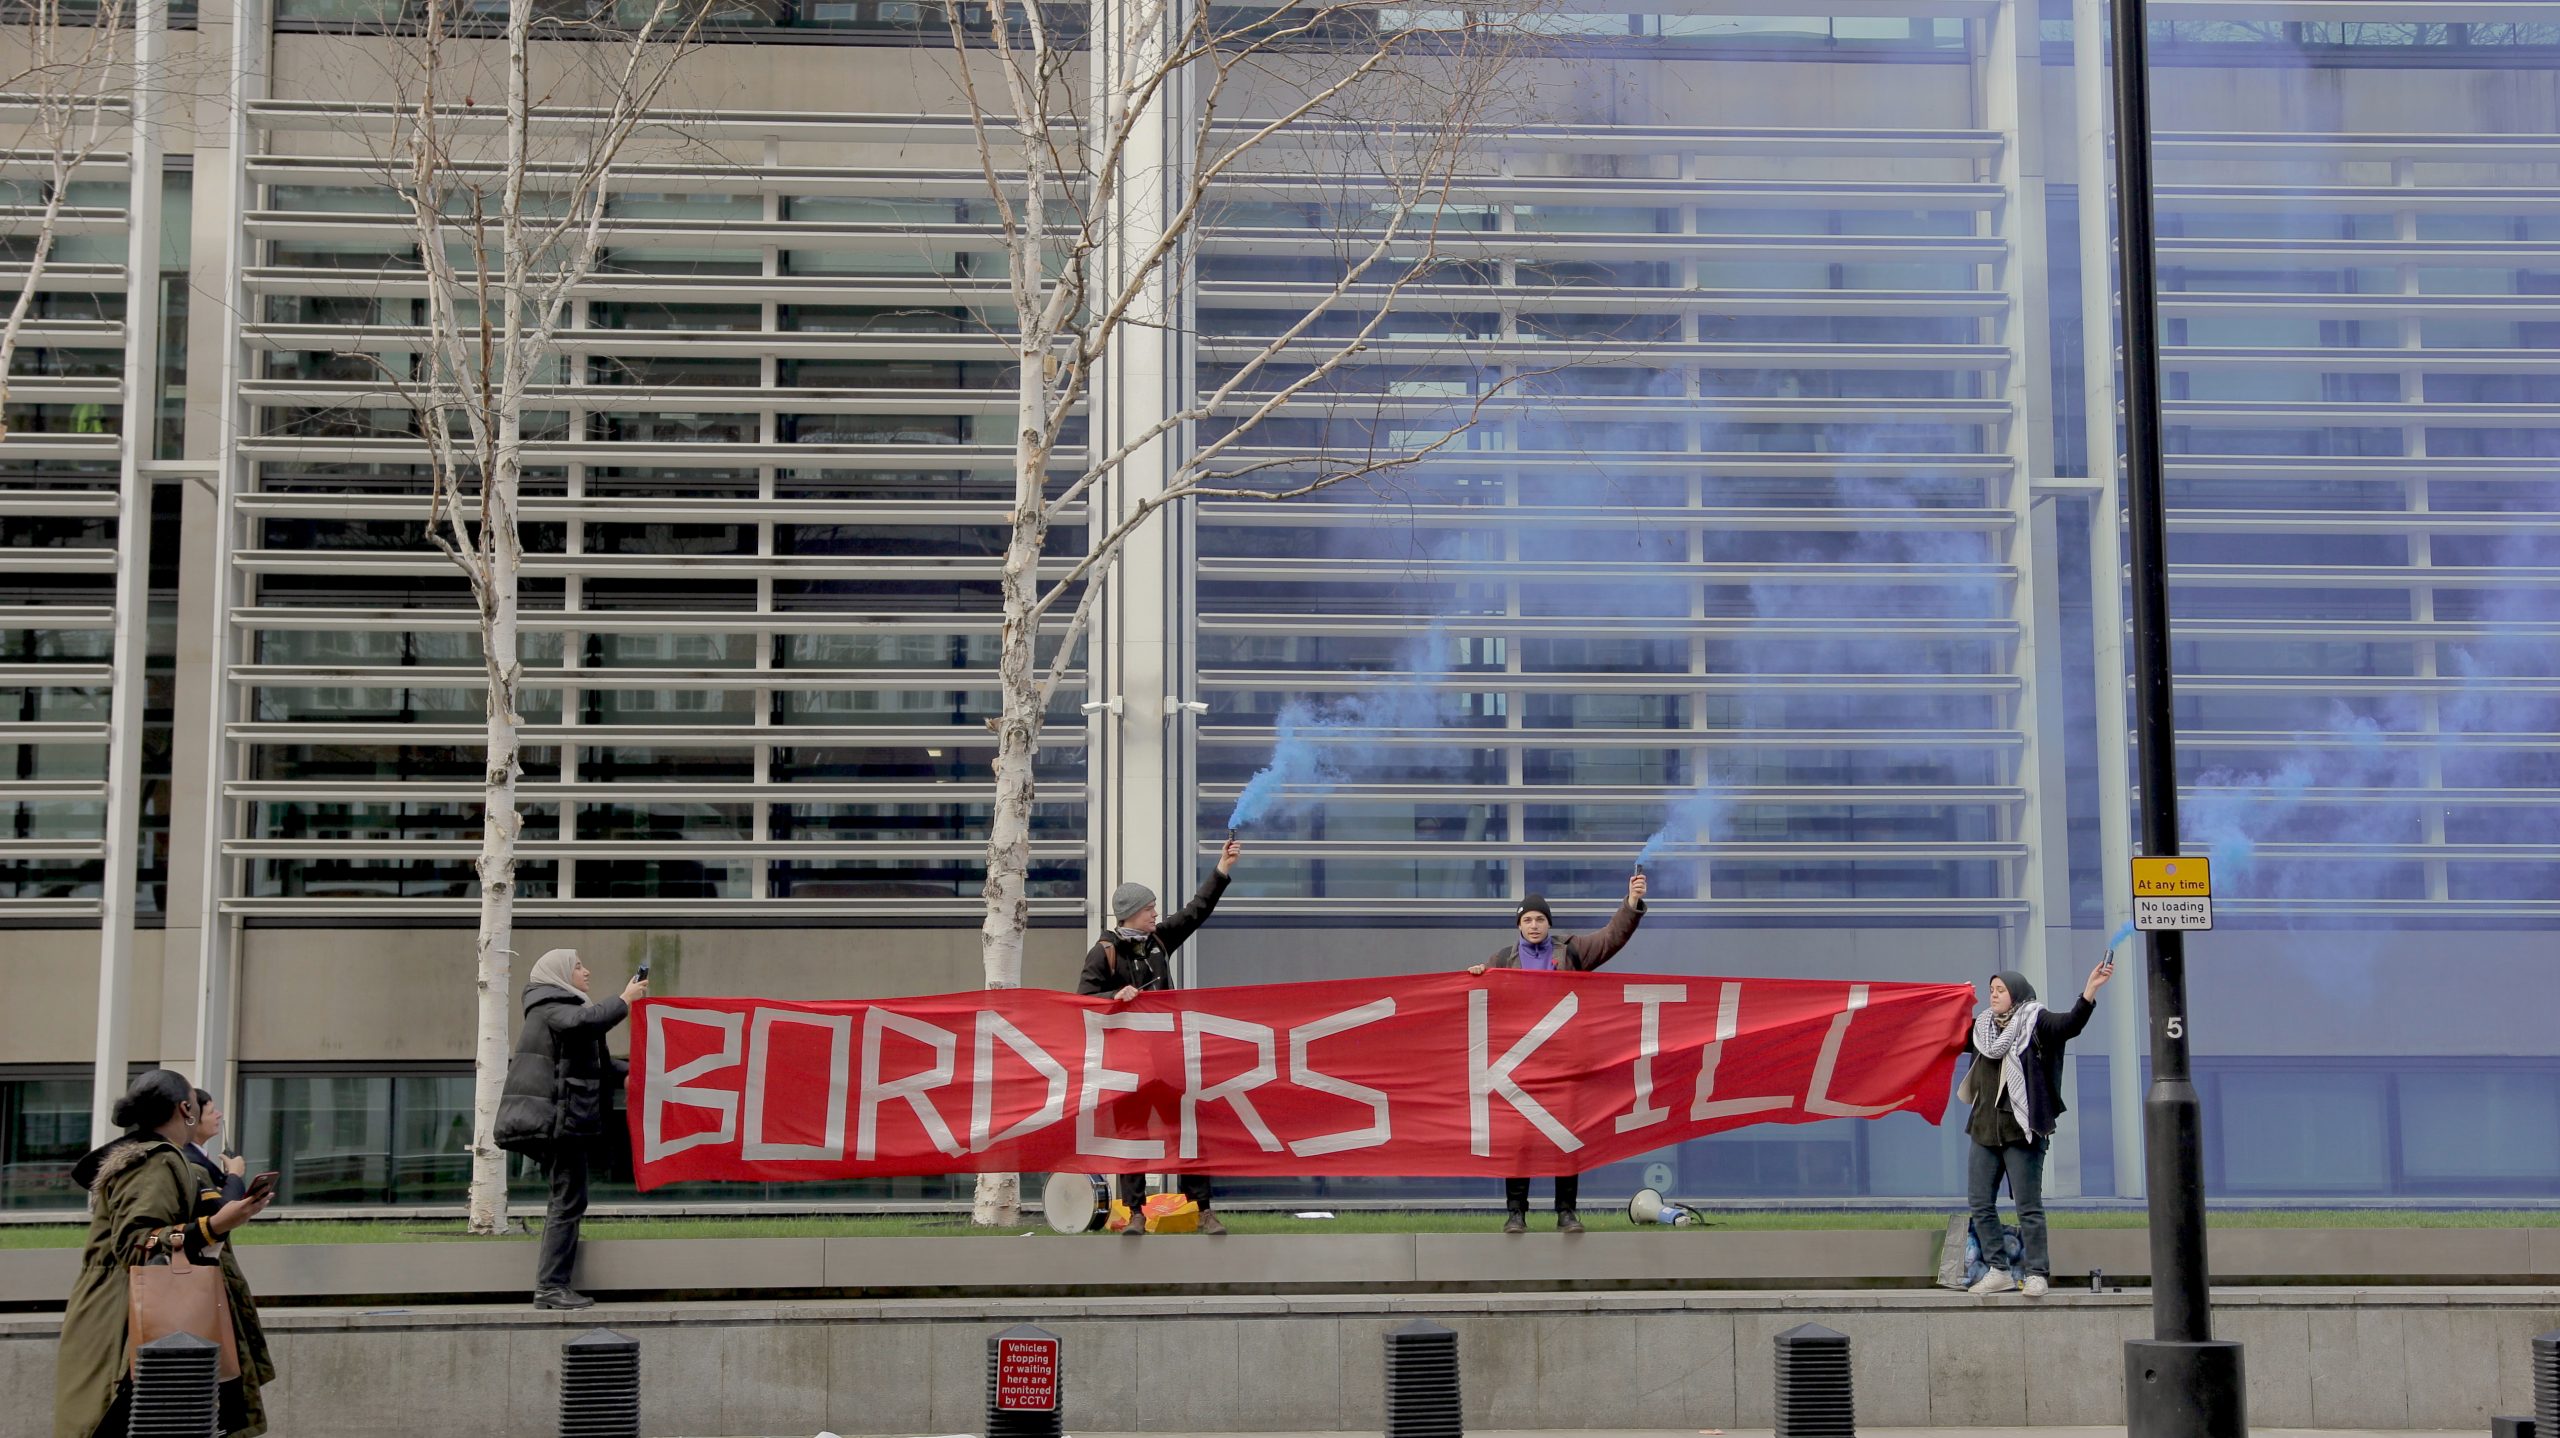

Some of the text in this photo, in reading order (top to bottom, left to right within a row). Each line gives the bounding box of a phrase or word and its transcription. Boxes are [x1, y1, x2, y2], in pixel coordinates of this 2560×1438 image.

[2138, 879, 2205, 891] At any time
[2141, 901, 2204, 913] No loading
[2140, 915, 2206, 926] at any time
[2166, 1016, 2183, 1039] 5
[643, 982, 1915, 1164] BORDERS KILL
[1009, 1343, 1047, 1352] Vehicles
[1007, 1354, 1048, 1364] stopping
[1003, 1365, 1051, 1375] or waiting
[1007, 1375, 1047, 1384] here are
[1001, 1386, 1051, 1395] monitored
[1005, 1396, 1048, 1406] by CCTV
